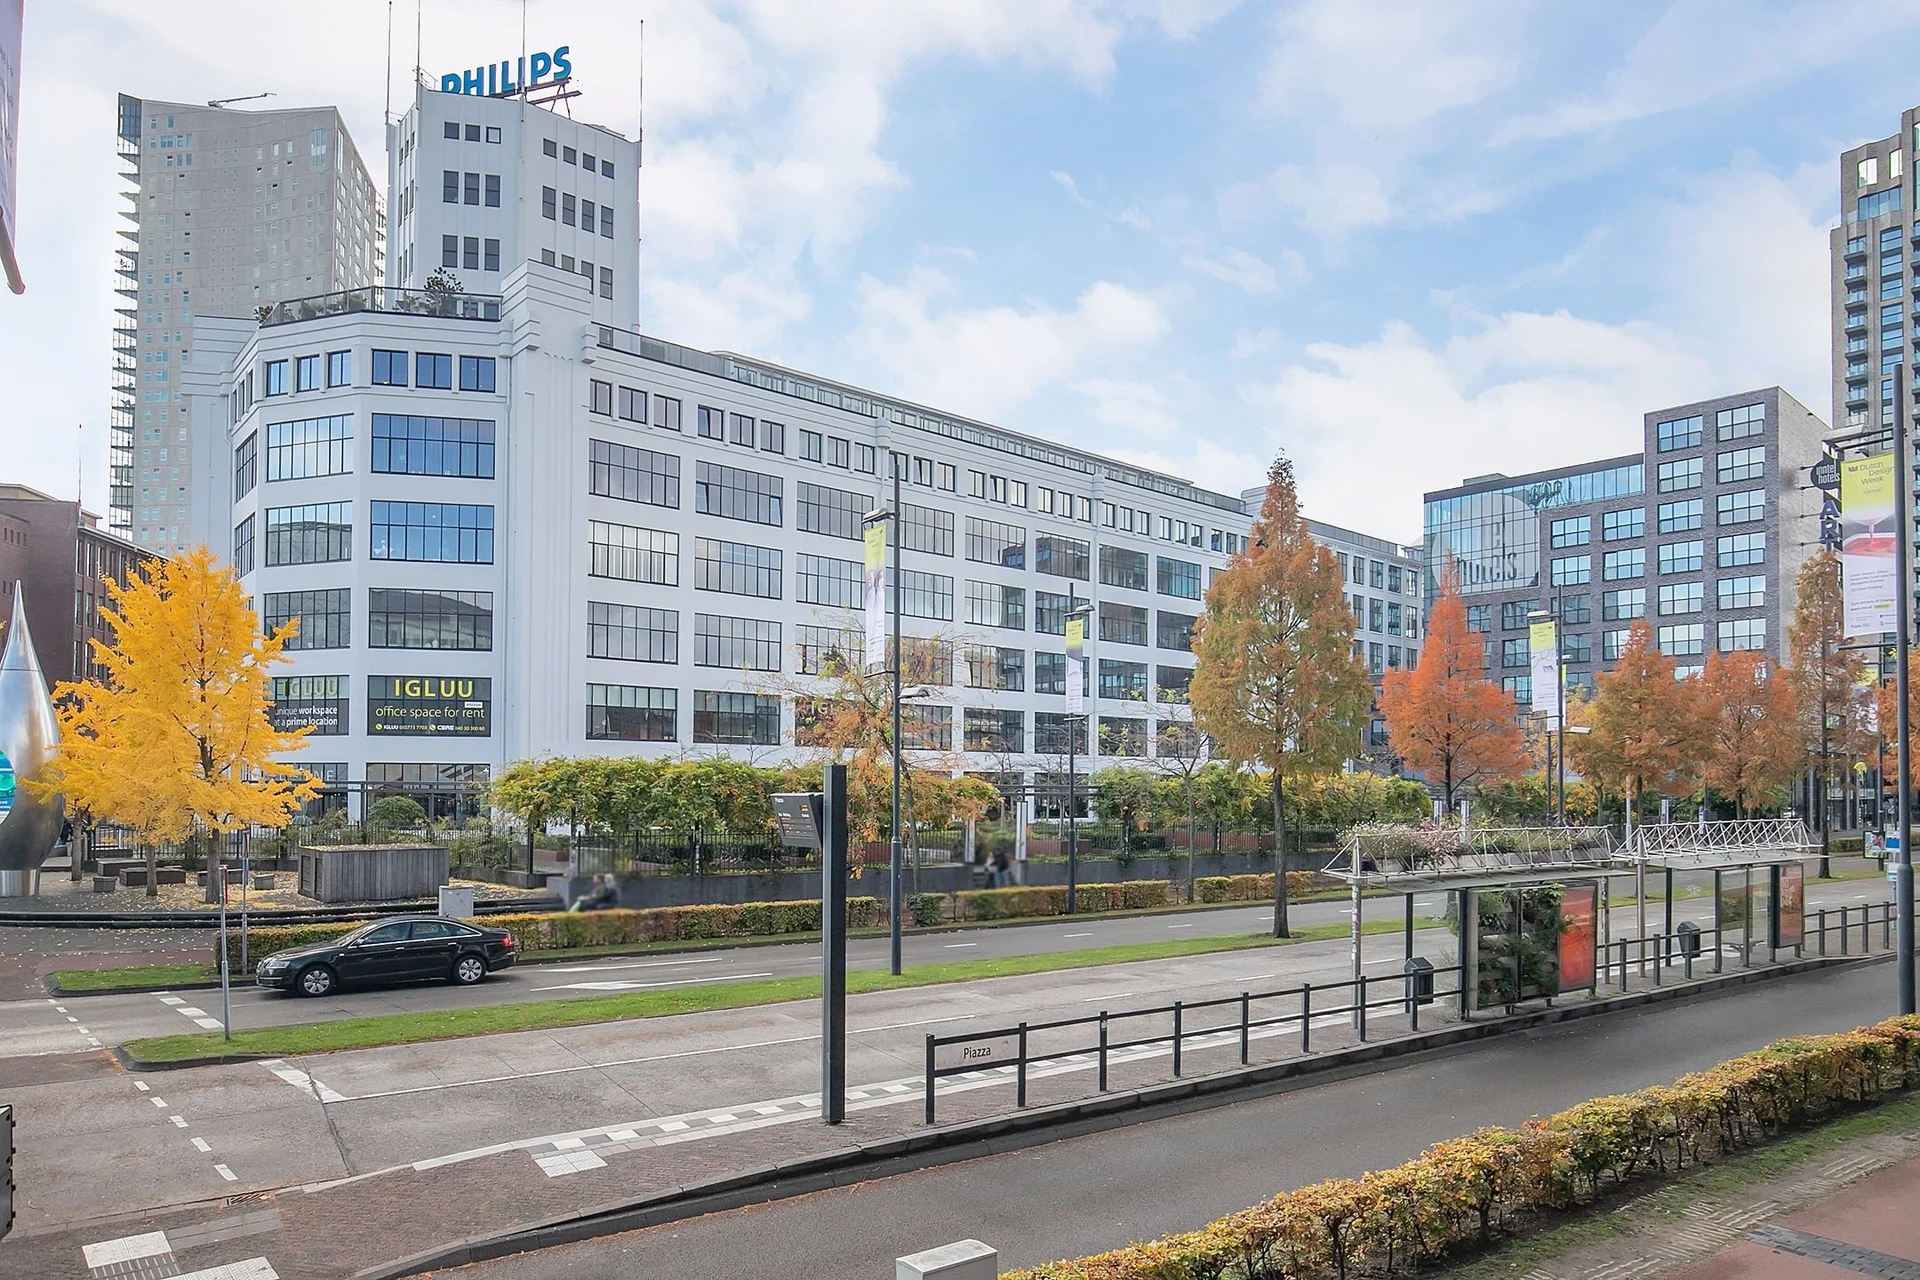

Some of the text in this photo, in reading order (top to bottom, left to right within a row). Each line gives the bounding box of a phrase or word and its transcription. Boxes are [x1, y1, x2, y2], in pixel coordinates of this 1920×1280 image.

[441, 46, 572, 97] PHILIPS
[1816, 459, 1836, 476] inntel
[1860, 461, 1884, 471] Dutch
[1818, 472, 1840, 484] hotels
[1861, 475, 1884, 485] Week
[394, 679, 473, 698] IGLUU
[275, 706, 338, 716] unique workspace
[375, 705, 485, 719] office space for rent
[286, 718, 307, 727] prime
[308, 717, 338, 726] location
[963, 1046, 991, 1059] Piazza
